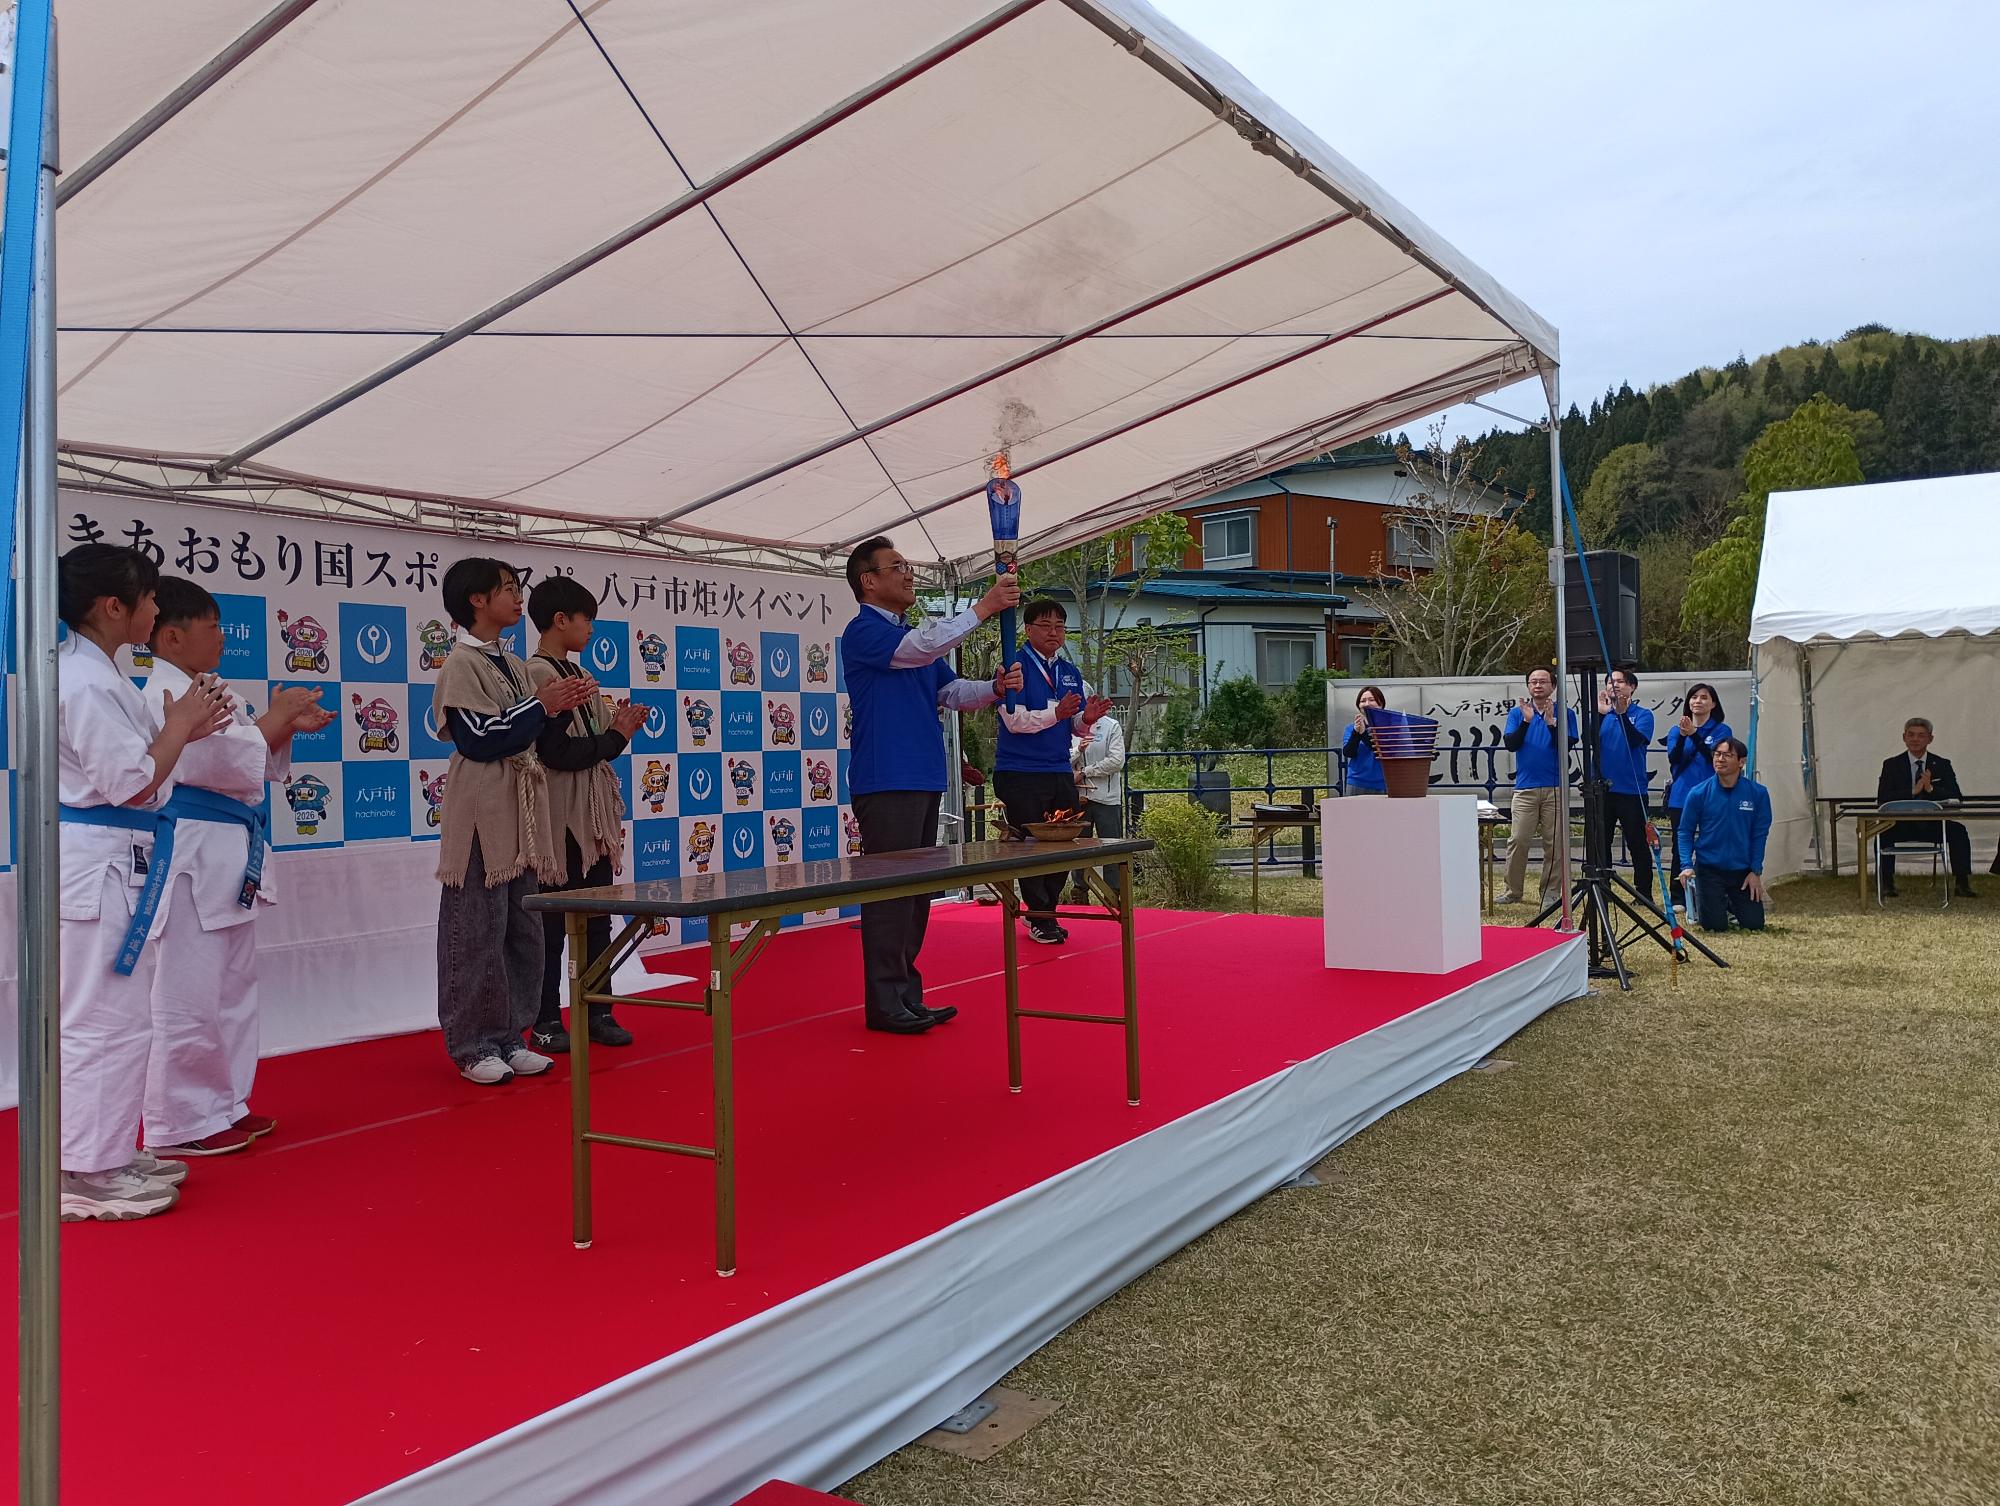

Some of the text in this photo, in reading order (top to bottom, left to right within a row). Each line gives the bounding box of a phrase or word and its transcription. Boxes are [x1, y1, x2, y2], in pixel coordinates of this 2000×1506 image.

[598, 572, 833, 625] 八戸市炬火イベント
[220, 623, 250, 641] 戸市
[296, 649, 313, 657] 2026
[684, 648, 711, 661] 八戸市
[728, 711, 754, 724] 八戸市
[292, 732, 326, 741] chinohe
[369, 730, 384, 738] 2026
[769, 769, 794, 782] 八戸市
[356, 786, 397, 802] 八戸市
[296, 811, 315, 820] 2026
[356, 809, 396, 819] hachinohe
[643, 838, 671, 854] 八戸市
